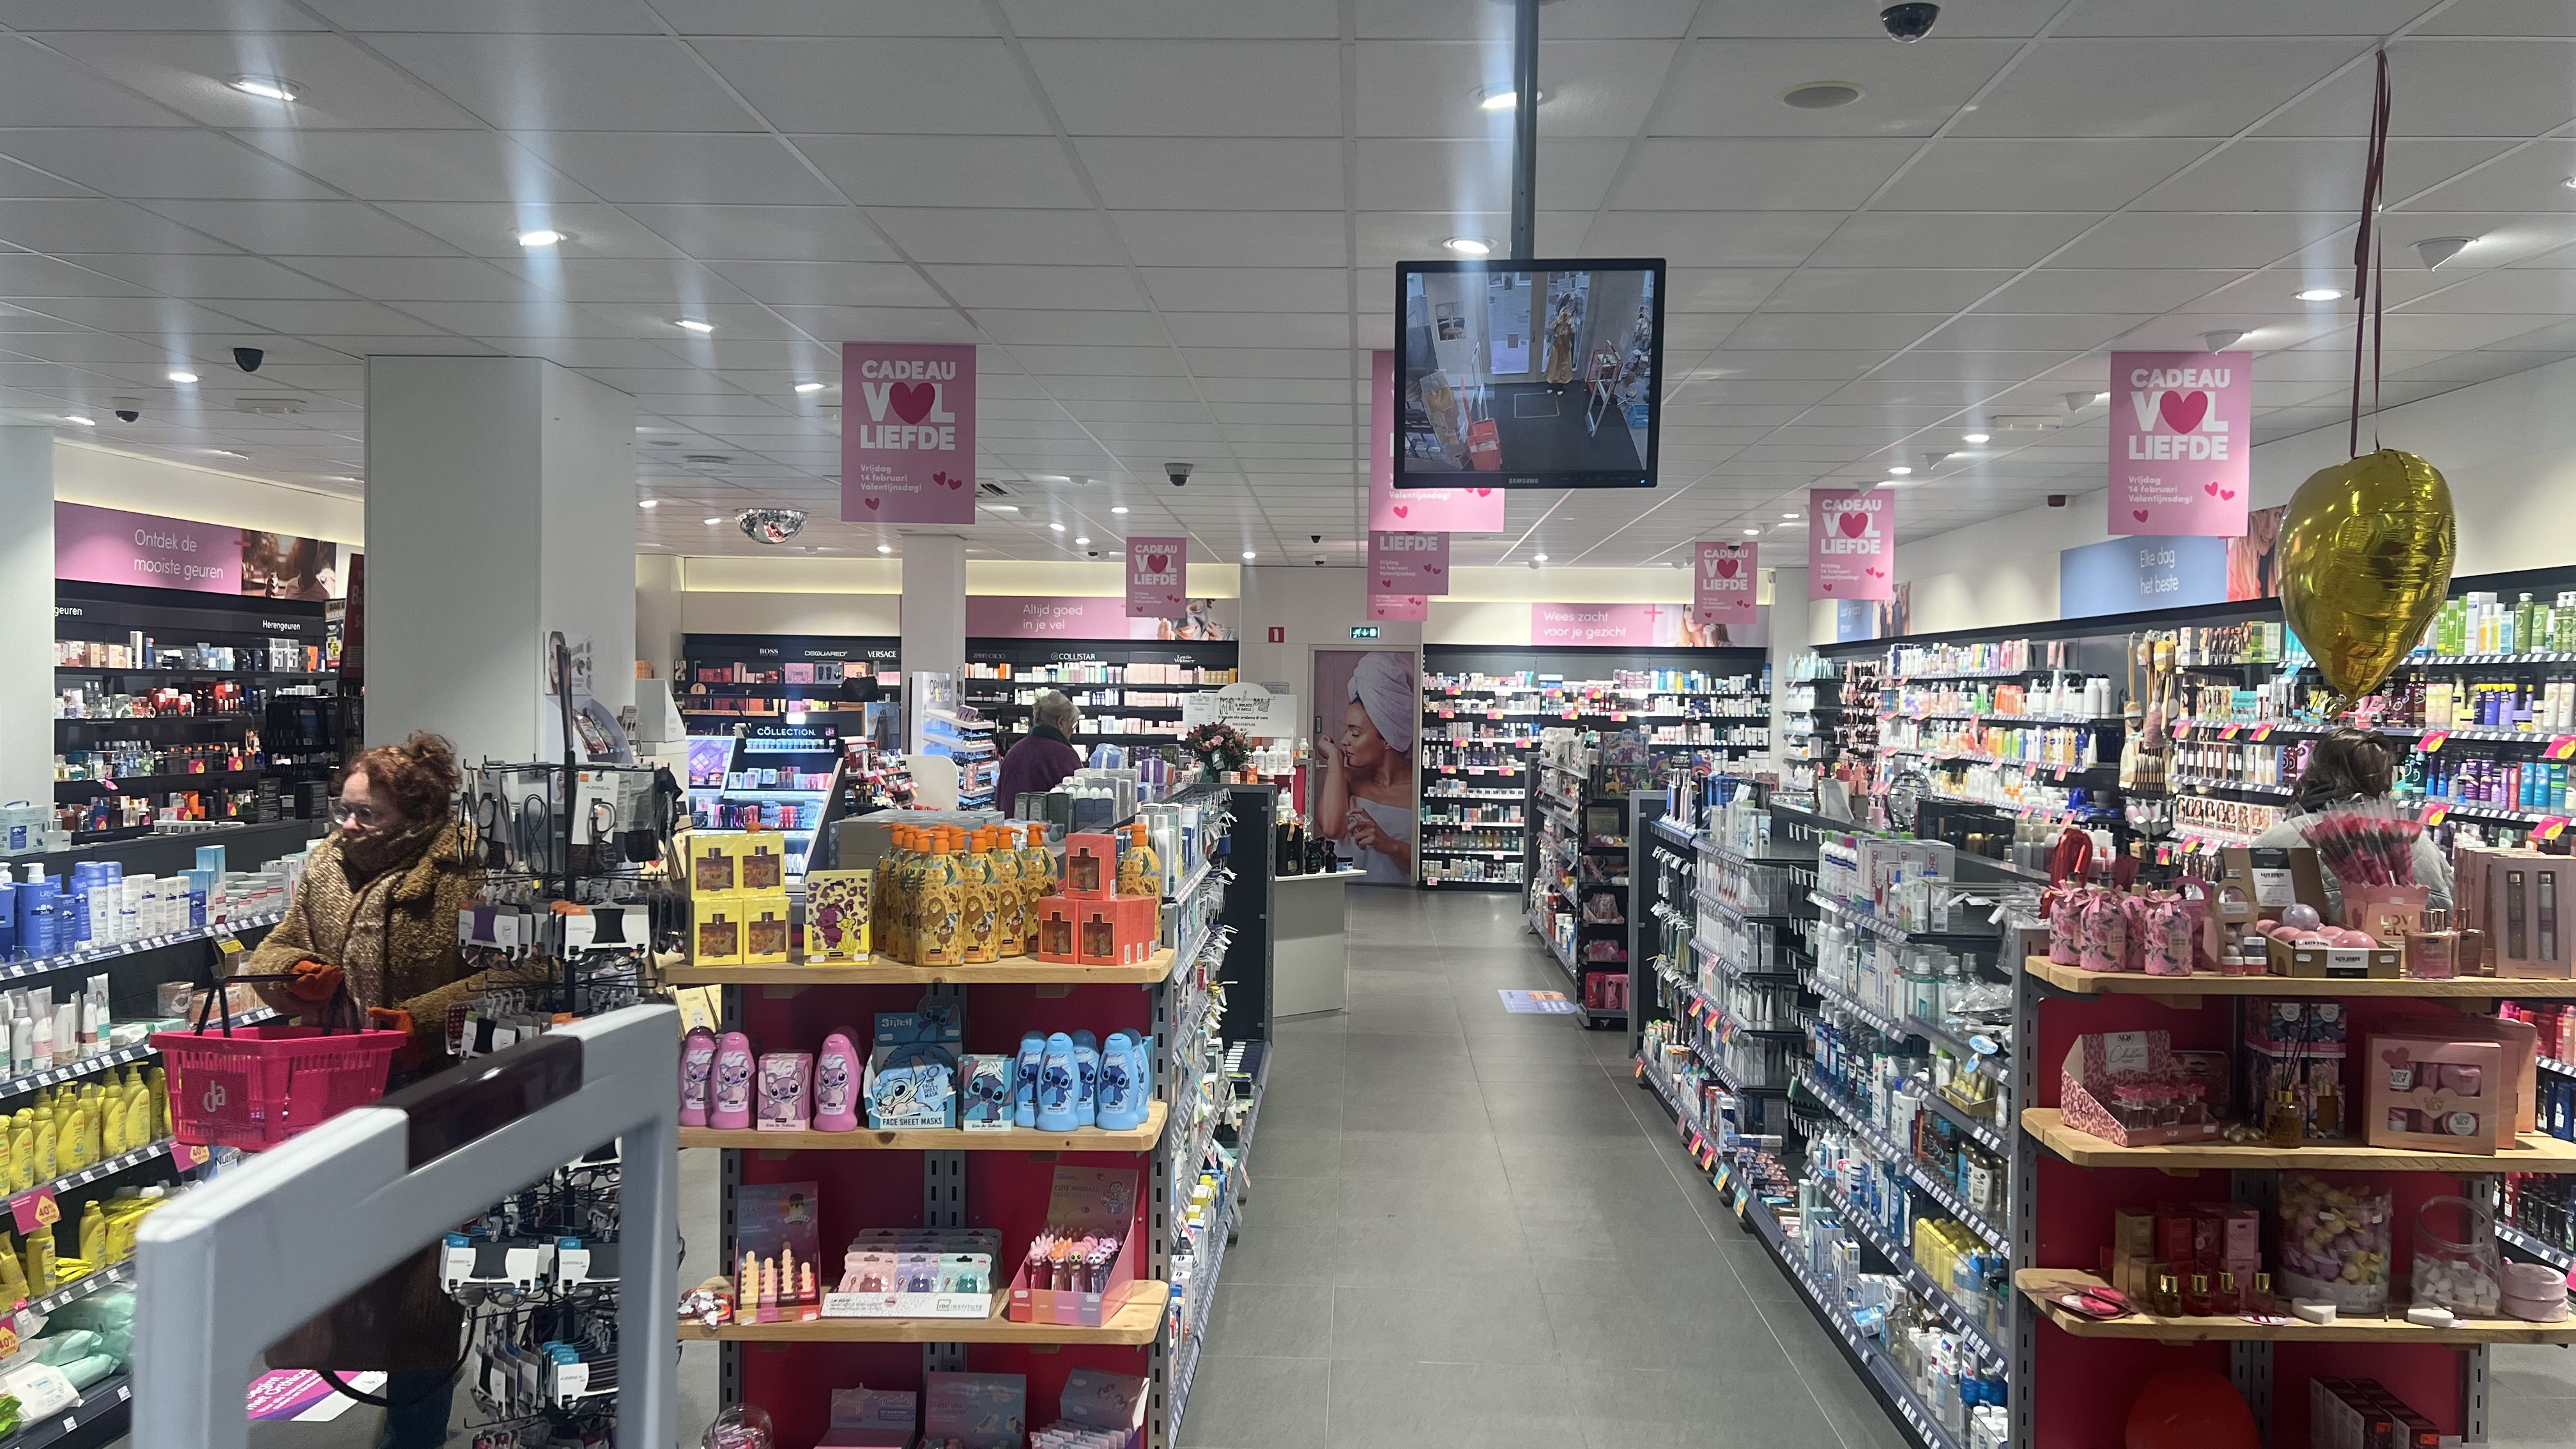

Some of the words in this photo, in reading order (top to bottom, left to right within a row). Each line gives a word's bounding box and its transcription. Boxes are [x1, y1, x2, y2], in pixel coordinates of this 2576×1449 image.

[861, 360, 956, 380] CADEAU
[2131, 369, 2231, 388] CADEAU
[860, 424, 956, 450] LIEFDE
[2129, 435, 2228, 460] LIEFDE
[861, 464, 891, 474] Vrijdag
[2128, 475, 2161, 486] Vrijdag
[861, 482, 922, 493] Valentijnsdag!
[1389, 491, 1450, 501] Valentijnsdag!
[2128, 494, 2193, 505] Valentijnsdag!
[1821, 499, 1882, 511] CADEAU
[135, 529, 178, 550] Ontdek
[181, 535, 197, 552] de
[1379, 536, 1438, 551] LIEFDE
[1821, 539, 1881, 554] LIEFDE
[1134, 544, 1178, 554] CADEAU
[1704, 549, 1749, 558] CADEAU
[2140, 550, 2155, 568] Elke
[2157, 548, 2175, 567] dag
[134, 558, 181, 575] mooiste
[184, 564, 224, 581] geuren
[1134, 574, 1177, 585] LIEFDE
[1703, 579, 1748, 591] LIEFDE
[2140, 576, 2152, 595] het
[2155, 576, 2179, 592] beste
[1023, 604, 1050, 617] Altijd
[1053, 604, 1083, 617] goed
[1544, 611, 1574, 621] Wees
[1577, 611, 1608, 622] zacht
[263, 620, 300, 632] Herengeuren
[1023, 619, 1032, 629] in
[1034, 619, 1046, 632] je
[1049, 619, 1065, 629] vel
[1571, 626, 1582, 639] je
[1586, 626, 1627, 640] gezicht
[2380, 915, 2412, 926] LOV
[203, 1080, 226, 1113] da
[38, 1204, 57, 1216] 40%
